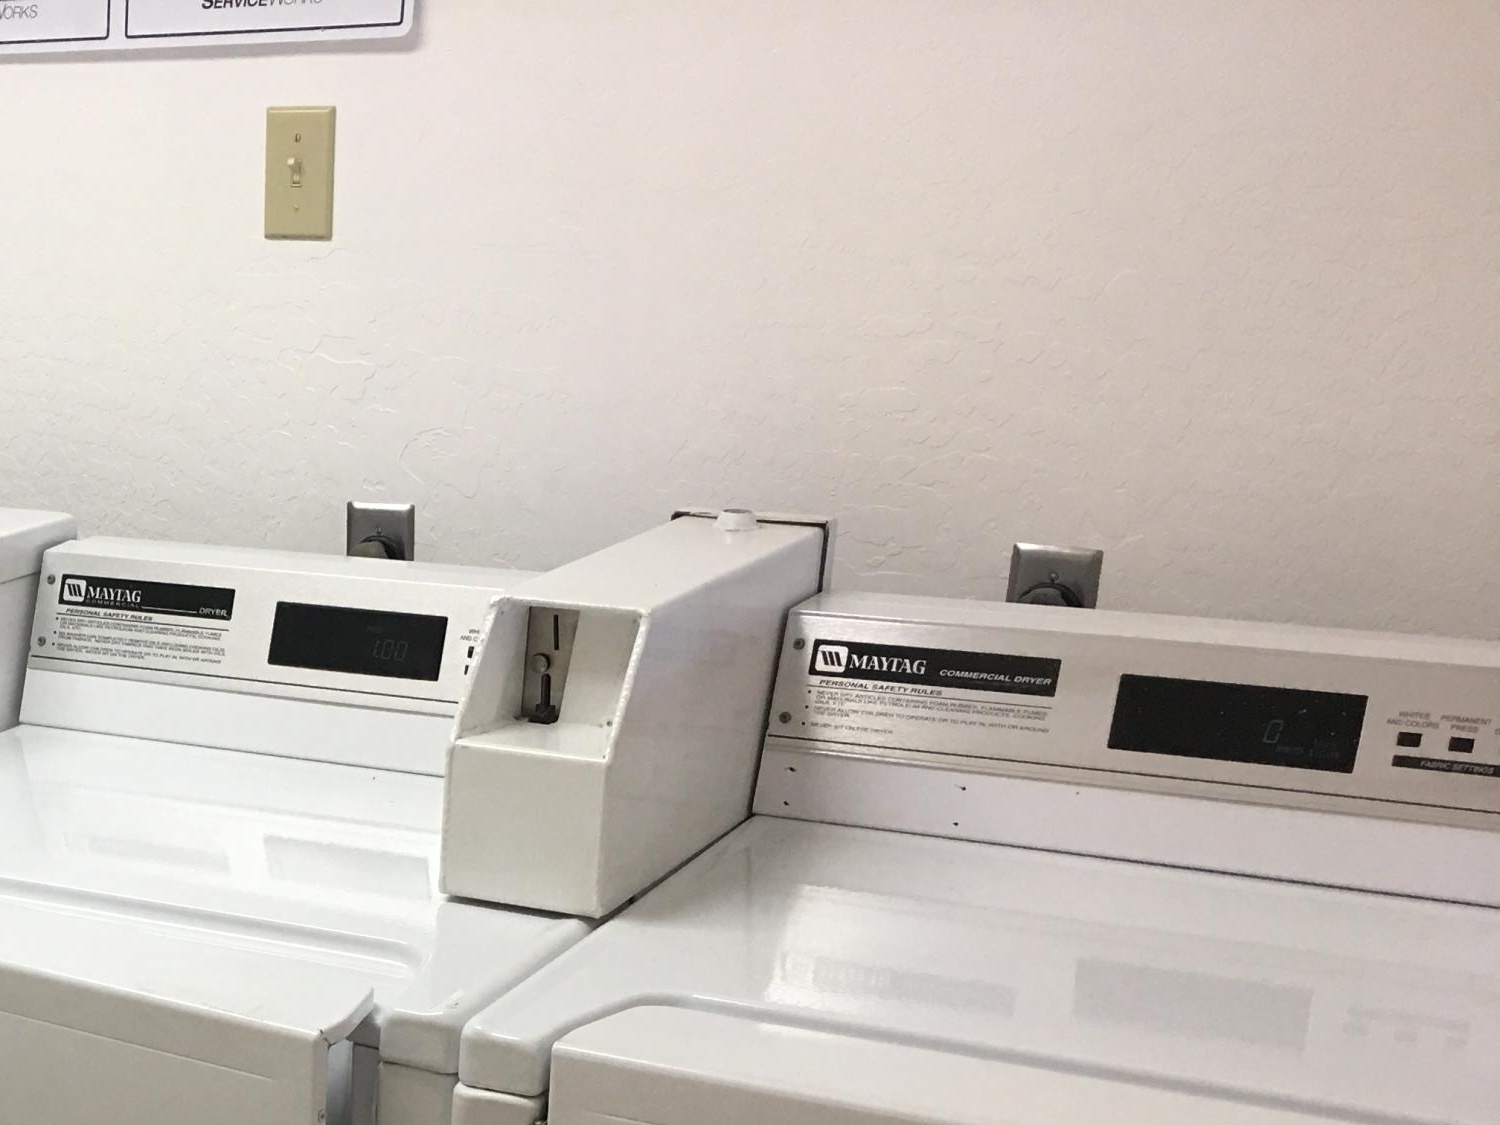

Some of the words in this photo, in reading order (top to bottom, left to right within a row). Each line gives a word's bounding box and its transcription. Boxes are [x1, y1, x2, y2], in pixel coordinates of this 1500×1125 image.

[86, 586, 142, 603] MAYTAG
[199, 607, 228, 617] DRYER
[849, 653, 927, 675] MAYTAG
[939, 669, 1012, 682] COMMERCIAL
[1013, 675, 1052, 686] DRYER
[819, 679, 870, 690] PERSONAL
[871, 683, 909, 693] SAFETY
[910, 687, 943, 697] RULES
